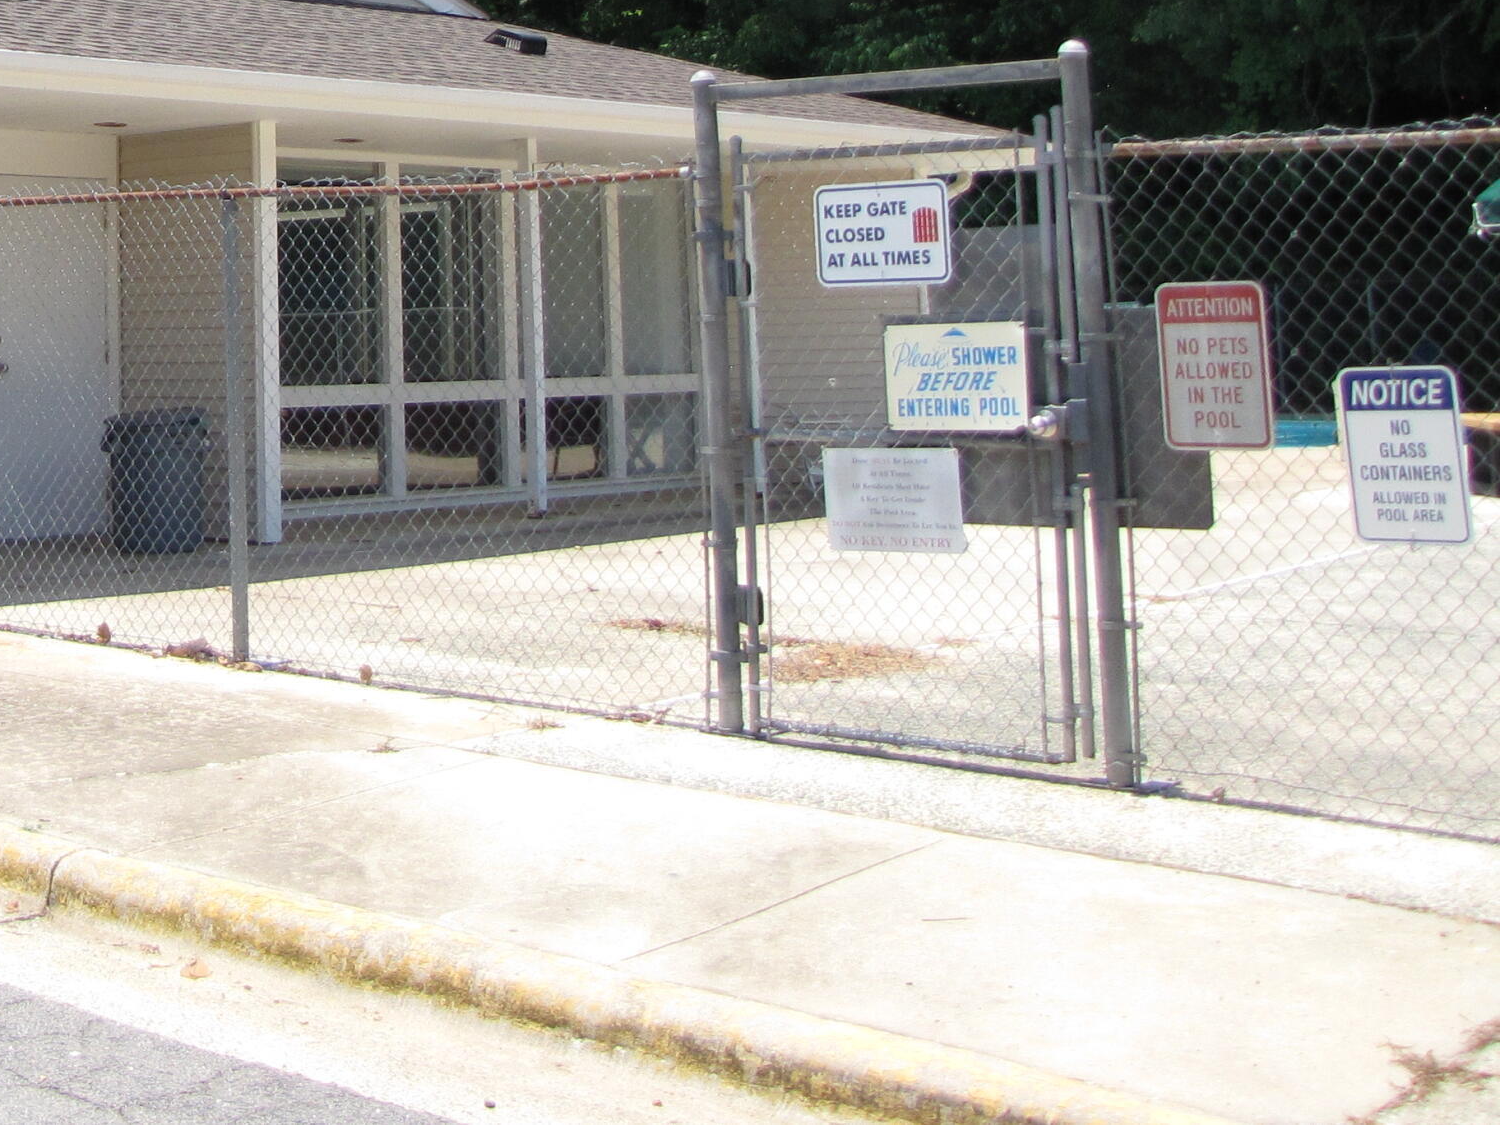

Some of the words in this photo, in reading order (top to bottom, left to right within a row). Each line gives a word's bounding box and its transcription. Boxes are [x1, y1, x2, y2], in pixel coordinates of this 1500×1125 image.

[823, 203, 862, 219] KEEP
[867, 200, 907, 217] GATE
[825, 227, 885, 243] CLOSED
[827, 253, 845, 268] AT
[851, 251, 878, 267] ALL
[882, 249, 931, 266] TIMES
[1166, 297, 1253, 318] ATTENTION
[1176, 338, 1199, 355] NO
[1207, 337, 1249, 355] PETS
[892, 341, 947, 376] Please
[952, 346, 1017, 366] SHOWER
[1175, 362, 1253, 380] ALLOWED
[916, 371, 997, 392] BEFORE
[1187, 387, 1205, 404] IN
[1211, 386, 1244, 404] THE
[1351, 378, 1443, 406] NOTICE
[897, 397, 970, 417] ENTERING
[979, 397, 1021, 416] POOL
[1194, 410, 1242, 429] POOL
[1390, 419, 1411, 436] NO
[1379, 442, 1427, 459] GLASS
[1360, 464, 1453, 482] CONTAINERS
[1372, 491, 1430, 505] ALLOWED
[1434, 491, 1447, 505] IN
[1377, 508, 1409, 522] POOL
[1412, 508, 1444, 522] AREA
[841, 536, 858, 546] NO
[891, 537, 908, 547] NO
[912, 537, 953, 549] ENTRY
